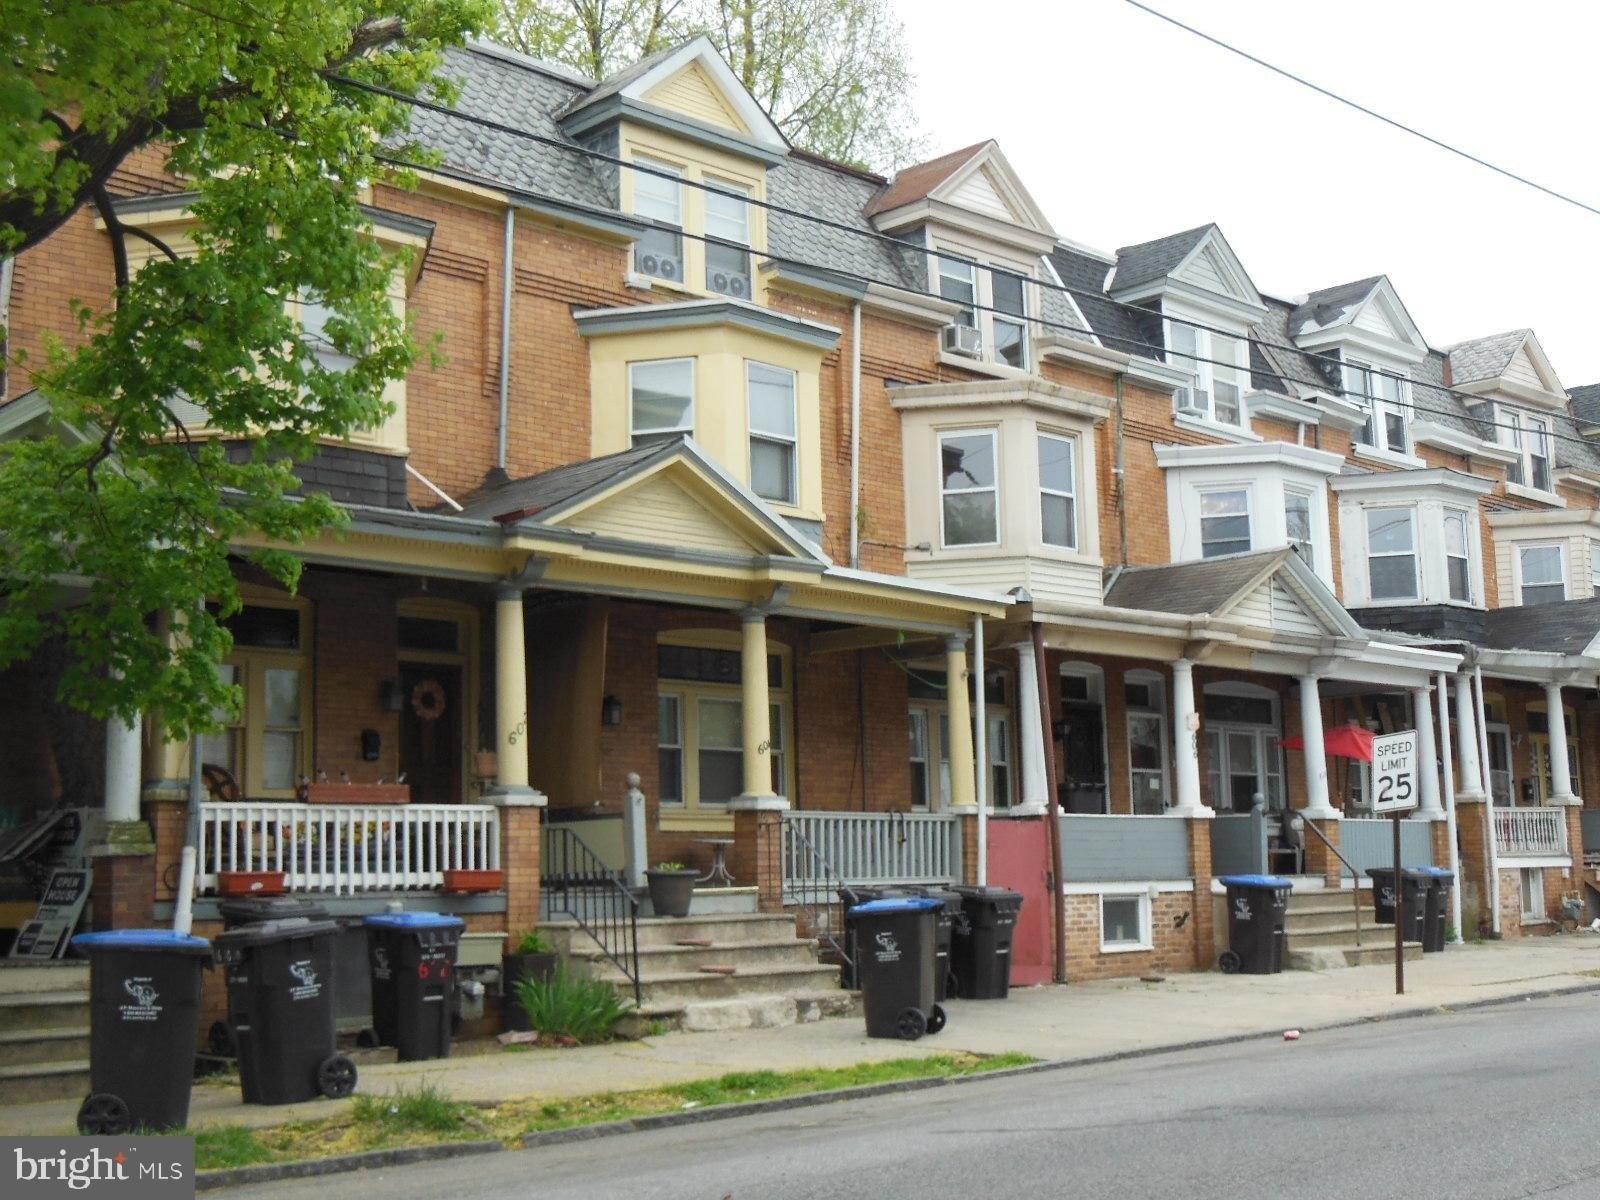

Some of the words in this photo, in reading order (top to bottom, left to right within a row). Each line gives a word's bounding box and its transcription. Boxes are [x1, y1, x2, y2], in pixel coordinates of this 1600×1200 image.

[1377, 741, 1412, 757] SPEED
[1381, 757, 1407, 771] LIMIT
[1378, 773, 1412, 802] 25
[56, 877, 80, 888] OPEN
[48, 889, 78, 901] HOUSE
